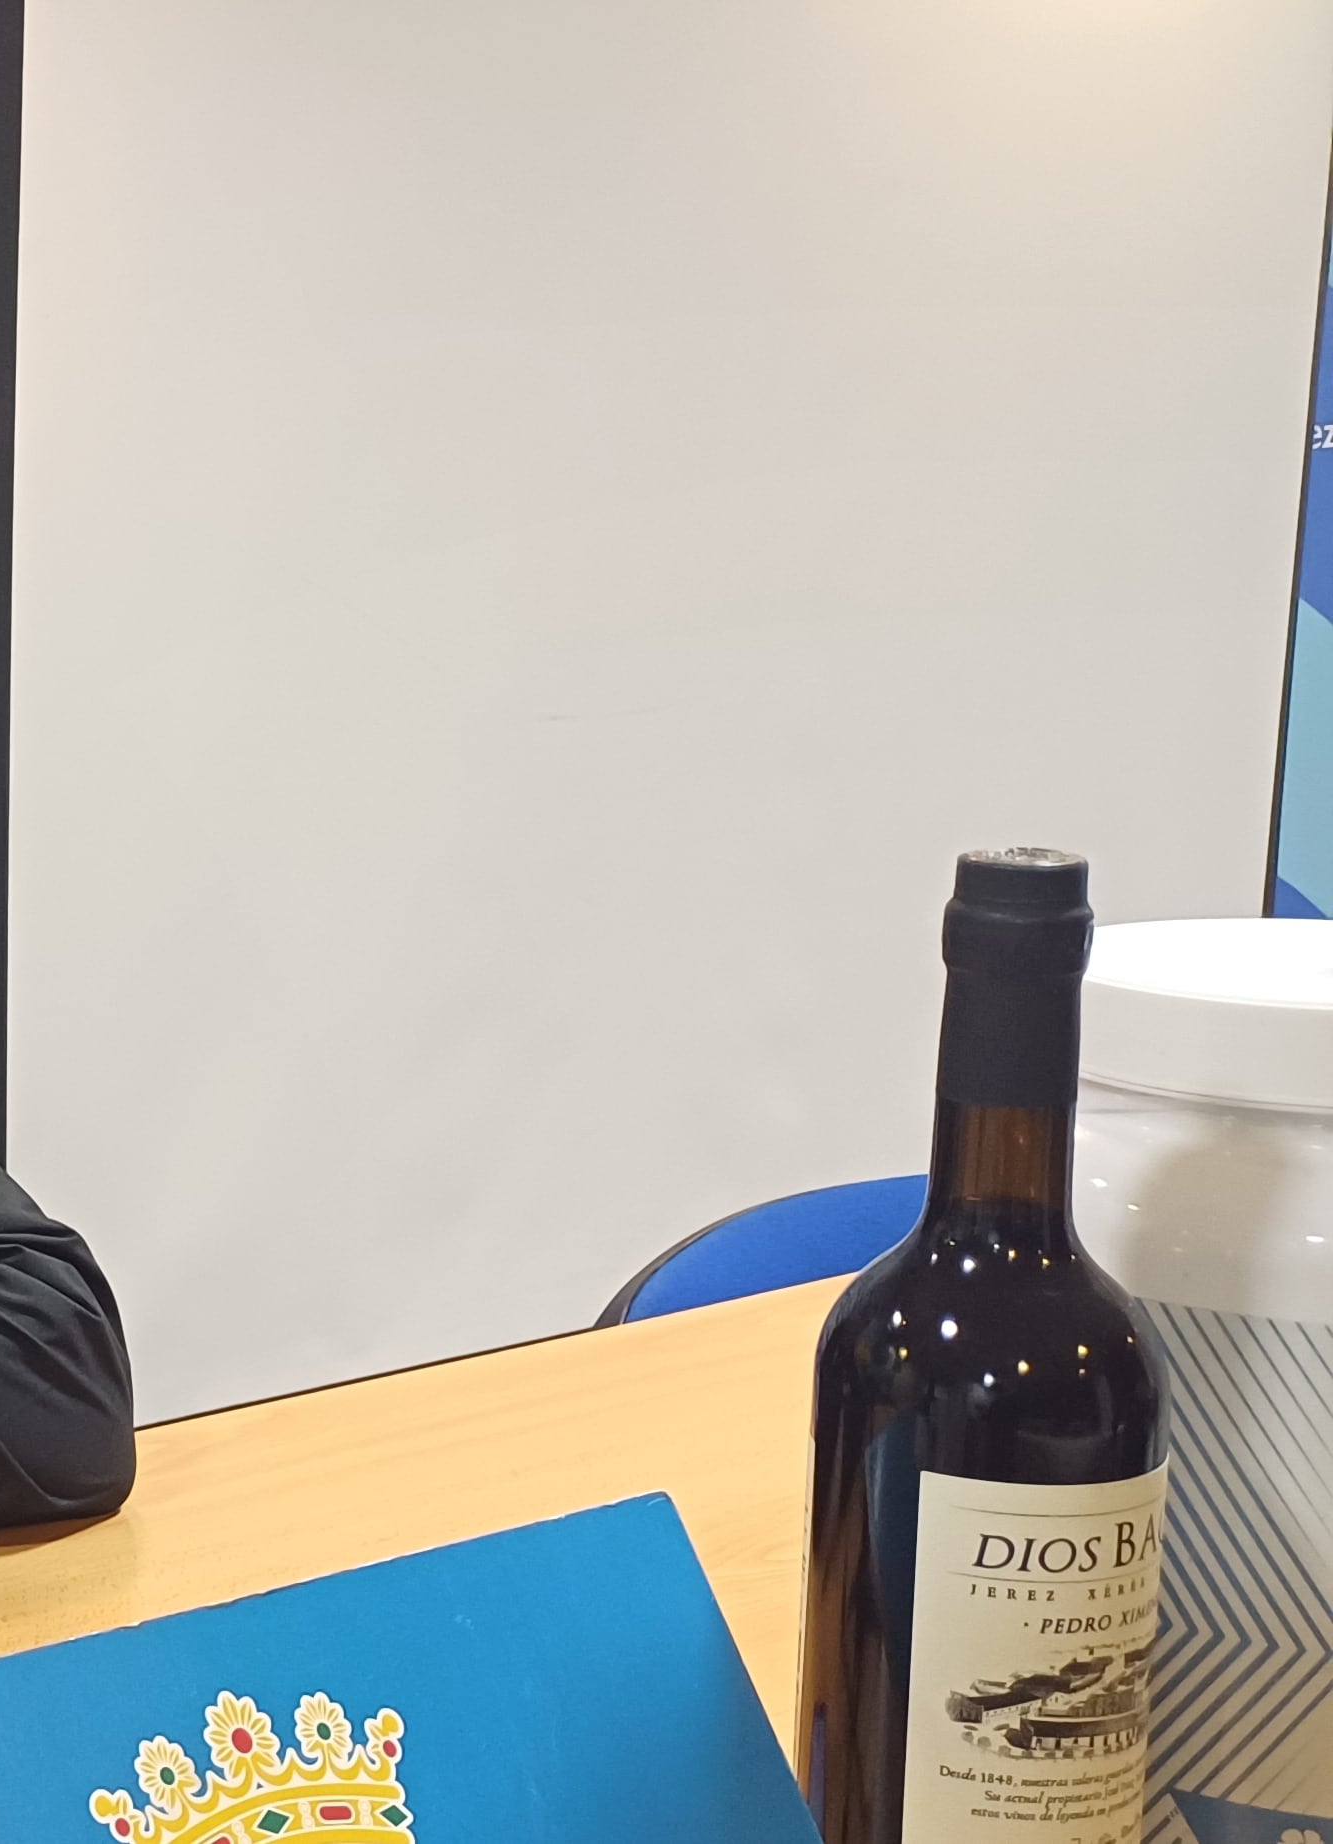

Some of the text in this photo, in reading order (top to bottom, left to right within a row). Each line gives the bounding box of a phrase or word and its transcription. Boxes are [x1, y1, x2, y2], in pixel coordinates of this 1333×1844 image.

[971, 1532, 1102, 1574] DIOS
[969, 1583, 1056, 1602] JEREZ
[1039, 1614, 1113, 1635] PEDRO
[939, 1764, 977, 1781] Desde
[984, 1790, 1001, 1802] Su
